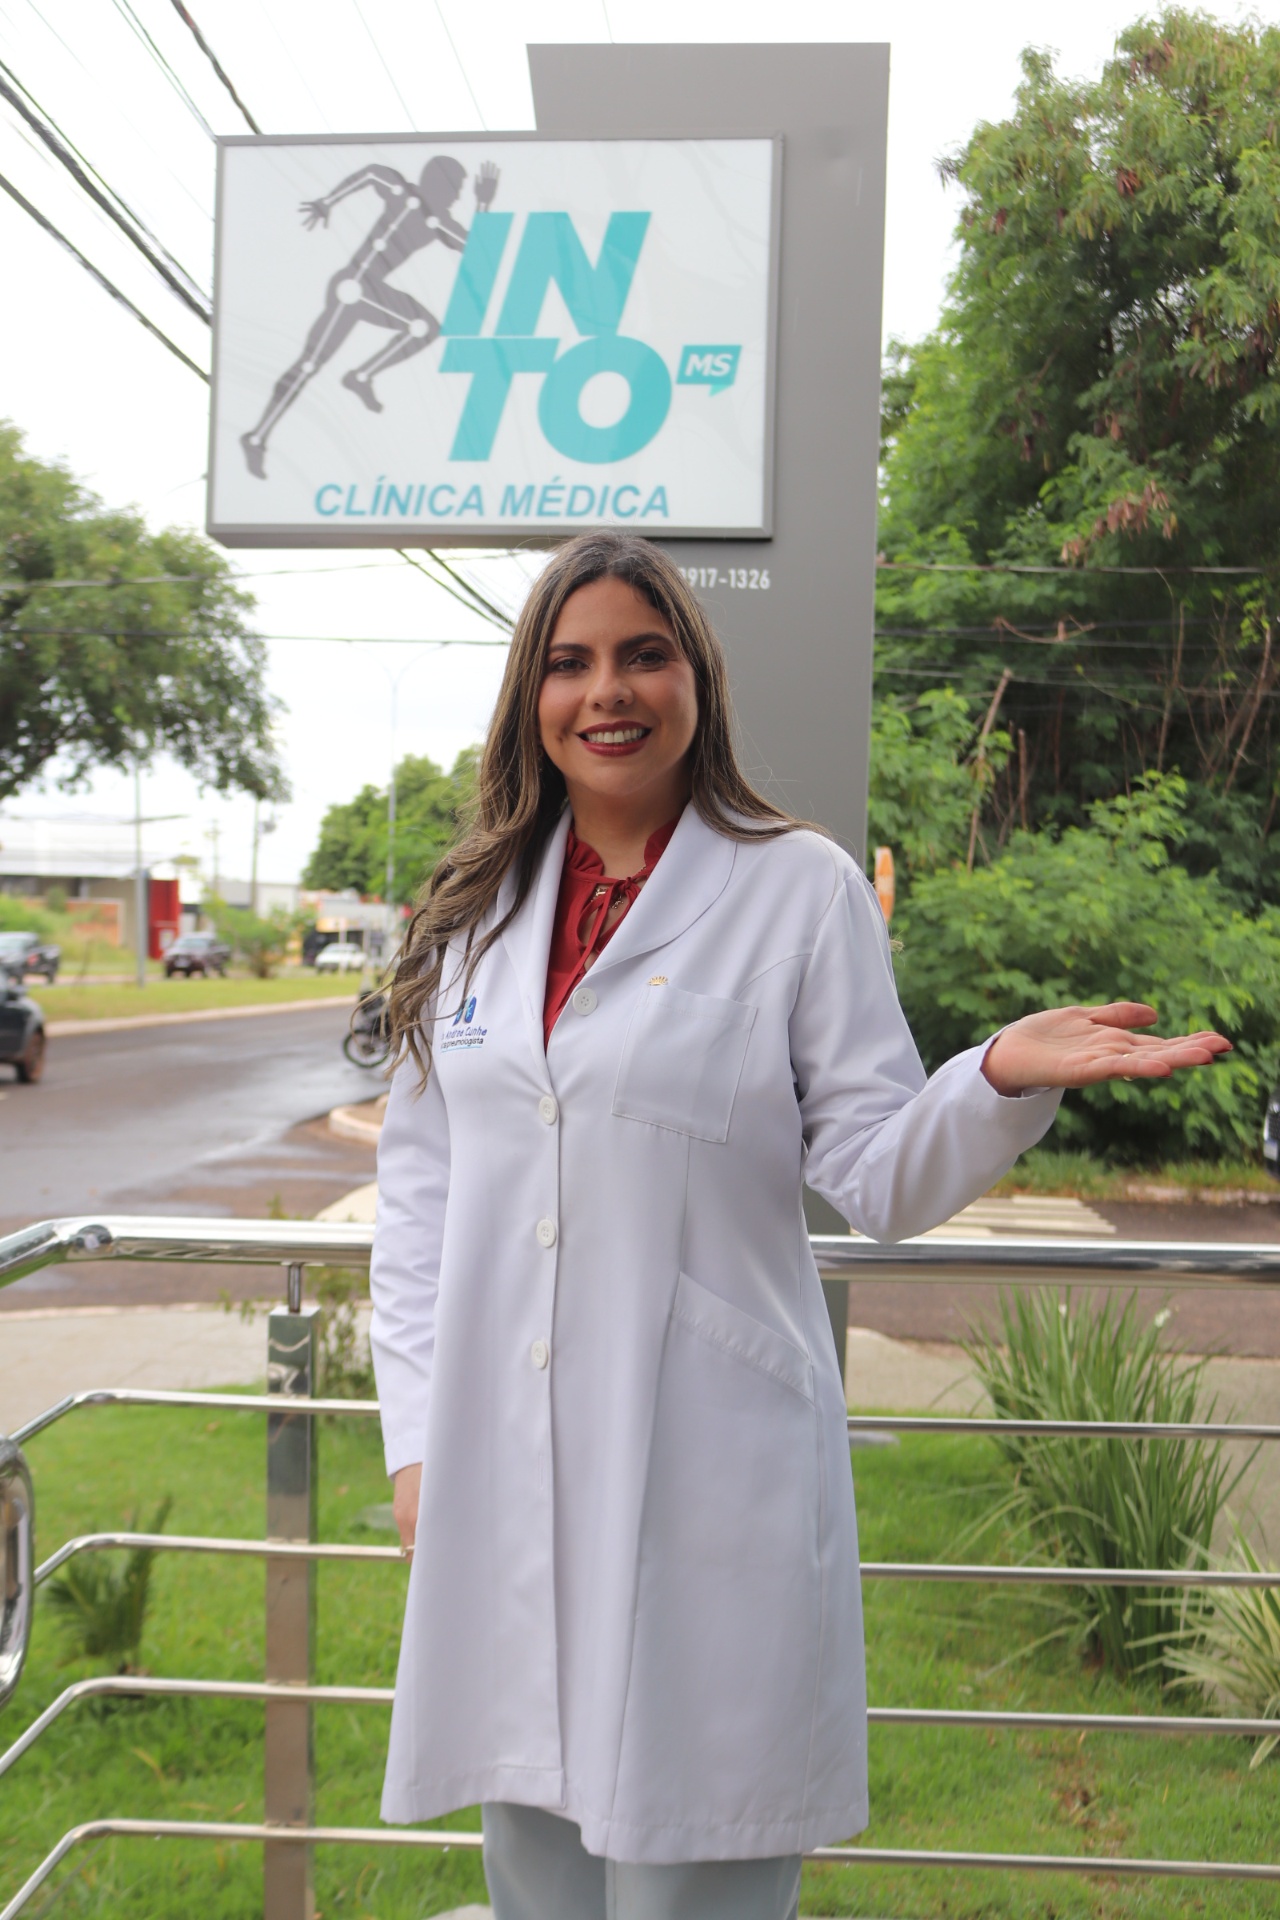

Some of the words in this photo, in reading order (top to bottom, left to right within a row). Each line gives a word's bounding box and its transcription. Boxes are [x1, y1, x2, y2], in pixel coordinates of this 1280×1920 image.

[439, 211, 652, 337] IN
[438, 336, 673, 464] TO
[684, 353, 734, 377] MS
[315, 475, 485, 517] CLÍNICA
[499, 477, 670, 518] MÉDICA
